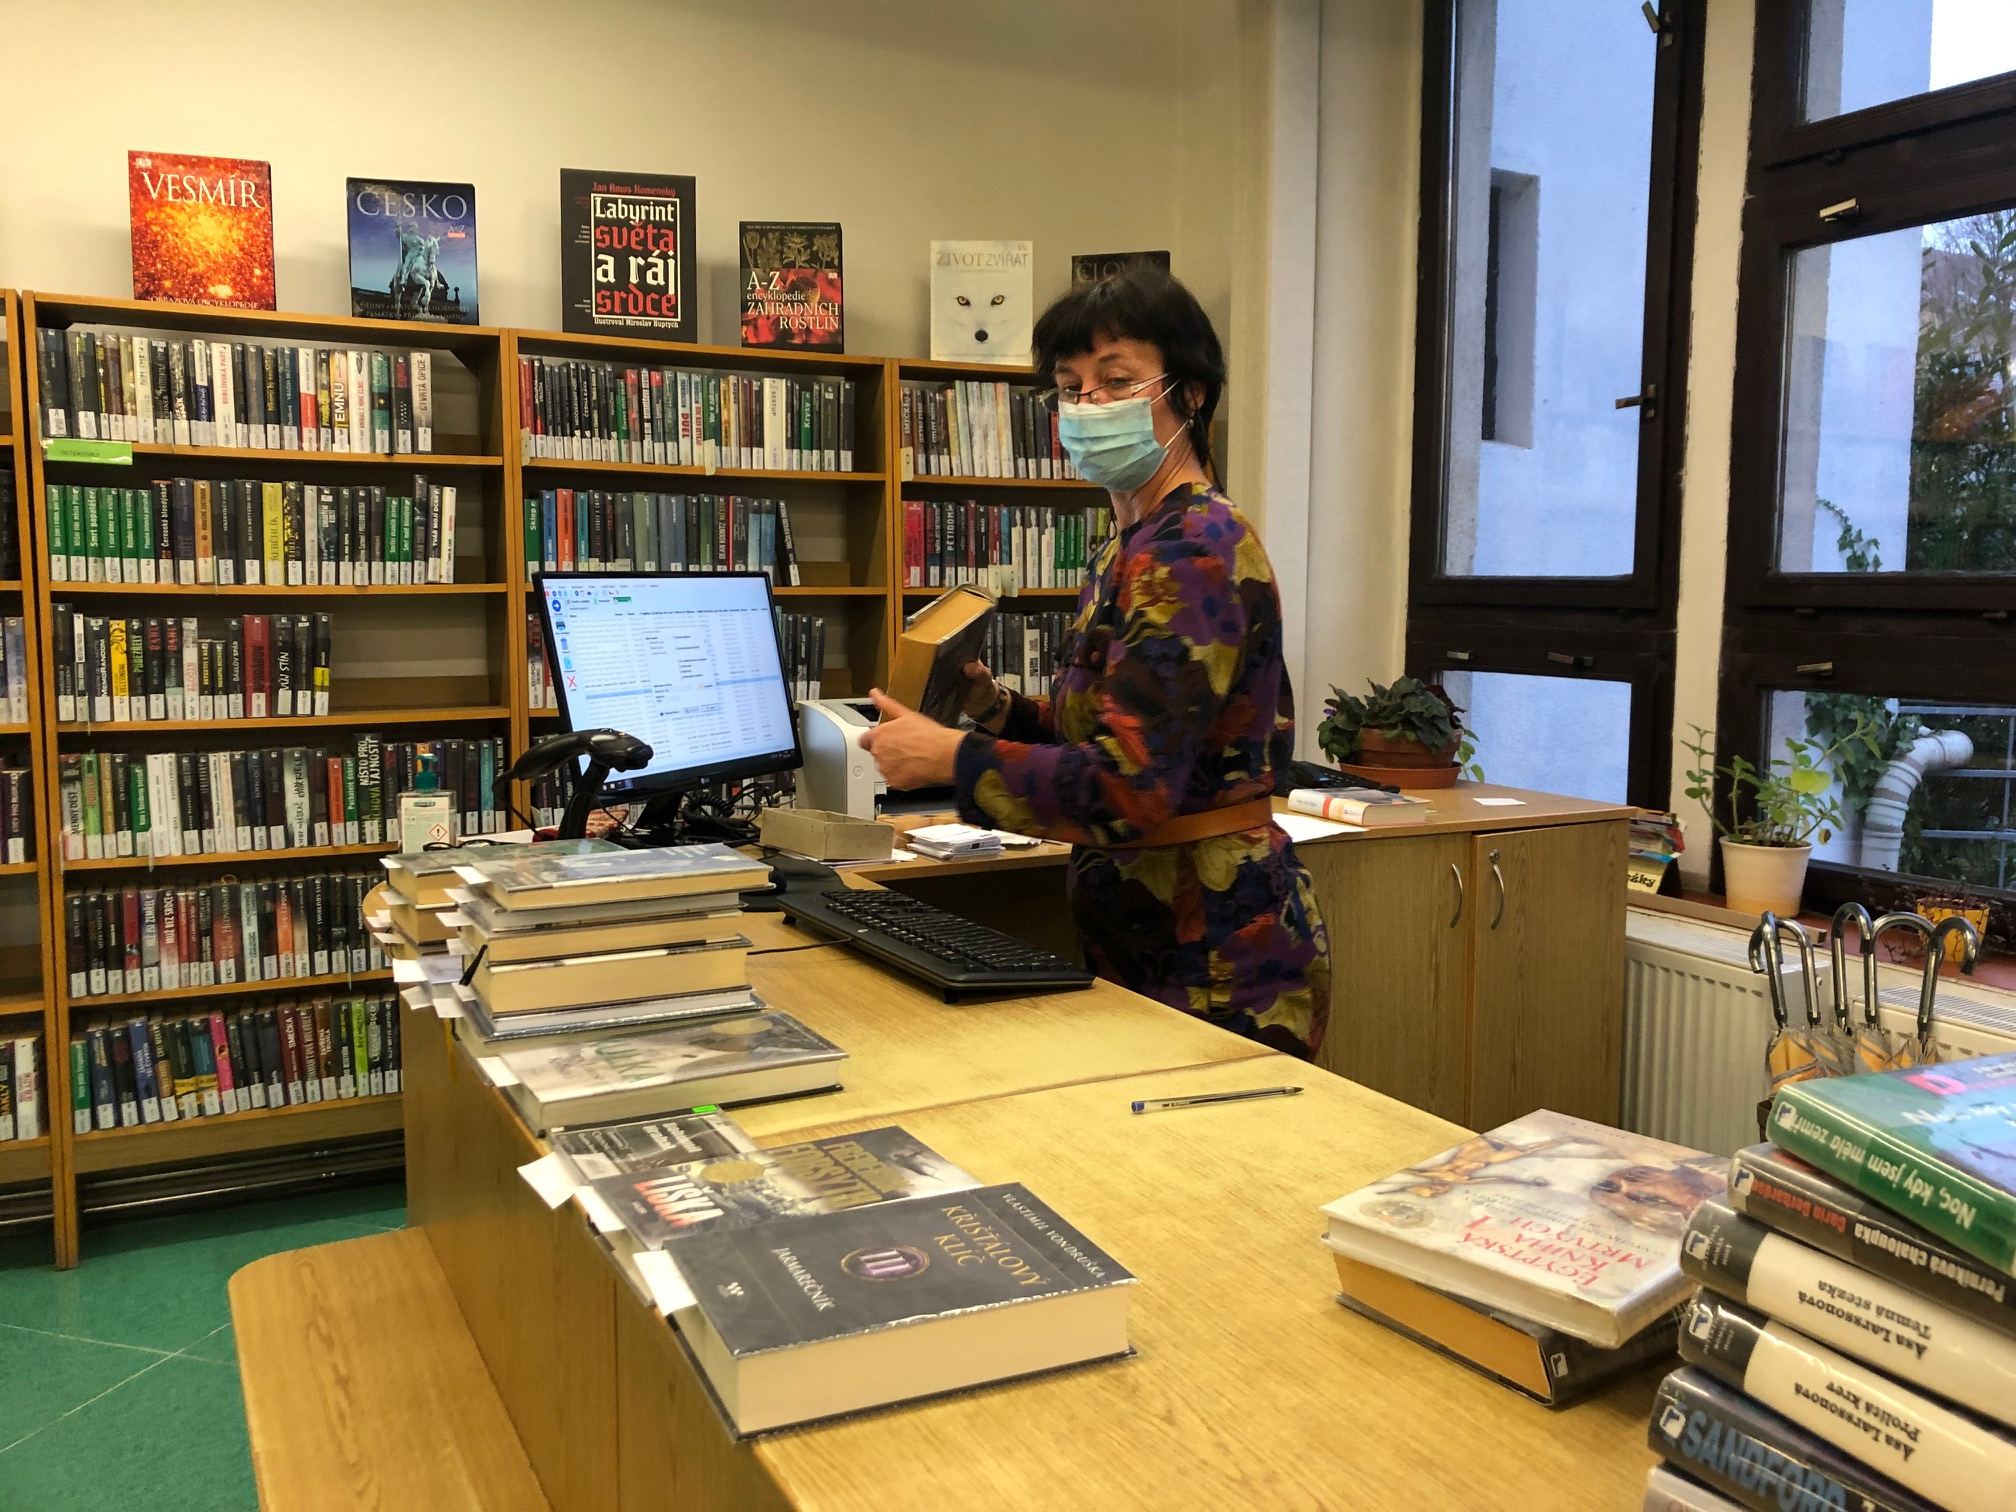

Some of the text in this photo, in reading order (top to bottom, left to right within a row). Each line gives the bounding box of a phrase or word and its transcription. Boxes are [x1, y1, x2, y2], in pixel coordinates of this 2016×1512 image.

[141, 171, 265, 209] VESMÍR
[356, 186, 467, 220] ČESKO
[594, 197, 675, 222] Labyrint
[595, 221, 675, 252] světa
[596, 249, 676, 295] a ráj
[747, 271, 781, 290] A-Z
[1076, 259, 1126, 283] ČLO
[596, 283, 676, 317] srdce
[747, 291, 806, 303] encyklopedie
[747, 301, 839, 316] ZAHRADNÍCH
[594, 317, 625, 326] Ilustroval
[779, 316, 839, 330] ROSTLIN
[417, 359, 427, 382] OPICE
[681, 413, 689, 438] DUEL
[803, 402, 811, 428] Krysy
[718, 522, 726, 544] KOONTZ
[718, 544, 726, 560] DEAN
[357, 740, 369, 786] MÍSTO PRO
[163, 896, 175, 944] MUŽ BEZ SRDCE
[286, 1018, 297, 1049] SMEČKA
[1792, 1111, 1978, 1230] Noc, kdy jsem měla zemř
[632, 1173, 726, 1229] LIŠKA
[940, 1204, 1048, 1289] KŘIŠŤÁLOVÝ
[1001, 1192, 1106, 1279] VLASTIMIL VONDRUŠKA
[1511, 1215, 1655, 1270] MRTVÝCH
[1513, 1232, 1610, 1275] KNIHA
[1853, 1222, 1927, 1263] chaloupka
[771, 1247, 837, 1311] JARMAREČNÍK
[1461, 1231, 1600, 1289] EGYPTSKÁ
[1797, 1289, 1930, 1361] Åsa Larssonová
[1817, 1279, 1932, 1340] Temná stezka
[1793, 1380, 1916, 1462] Åsa Larssonová
[1825, 1379, 1921, 1443] Prolitá krev
